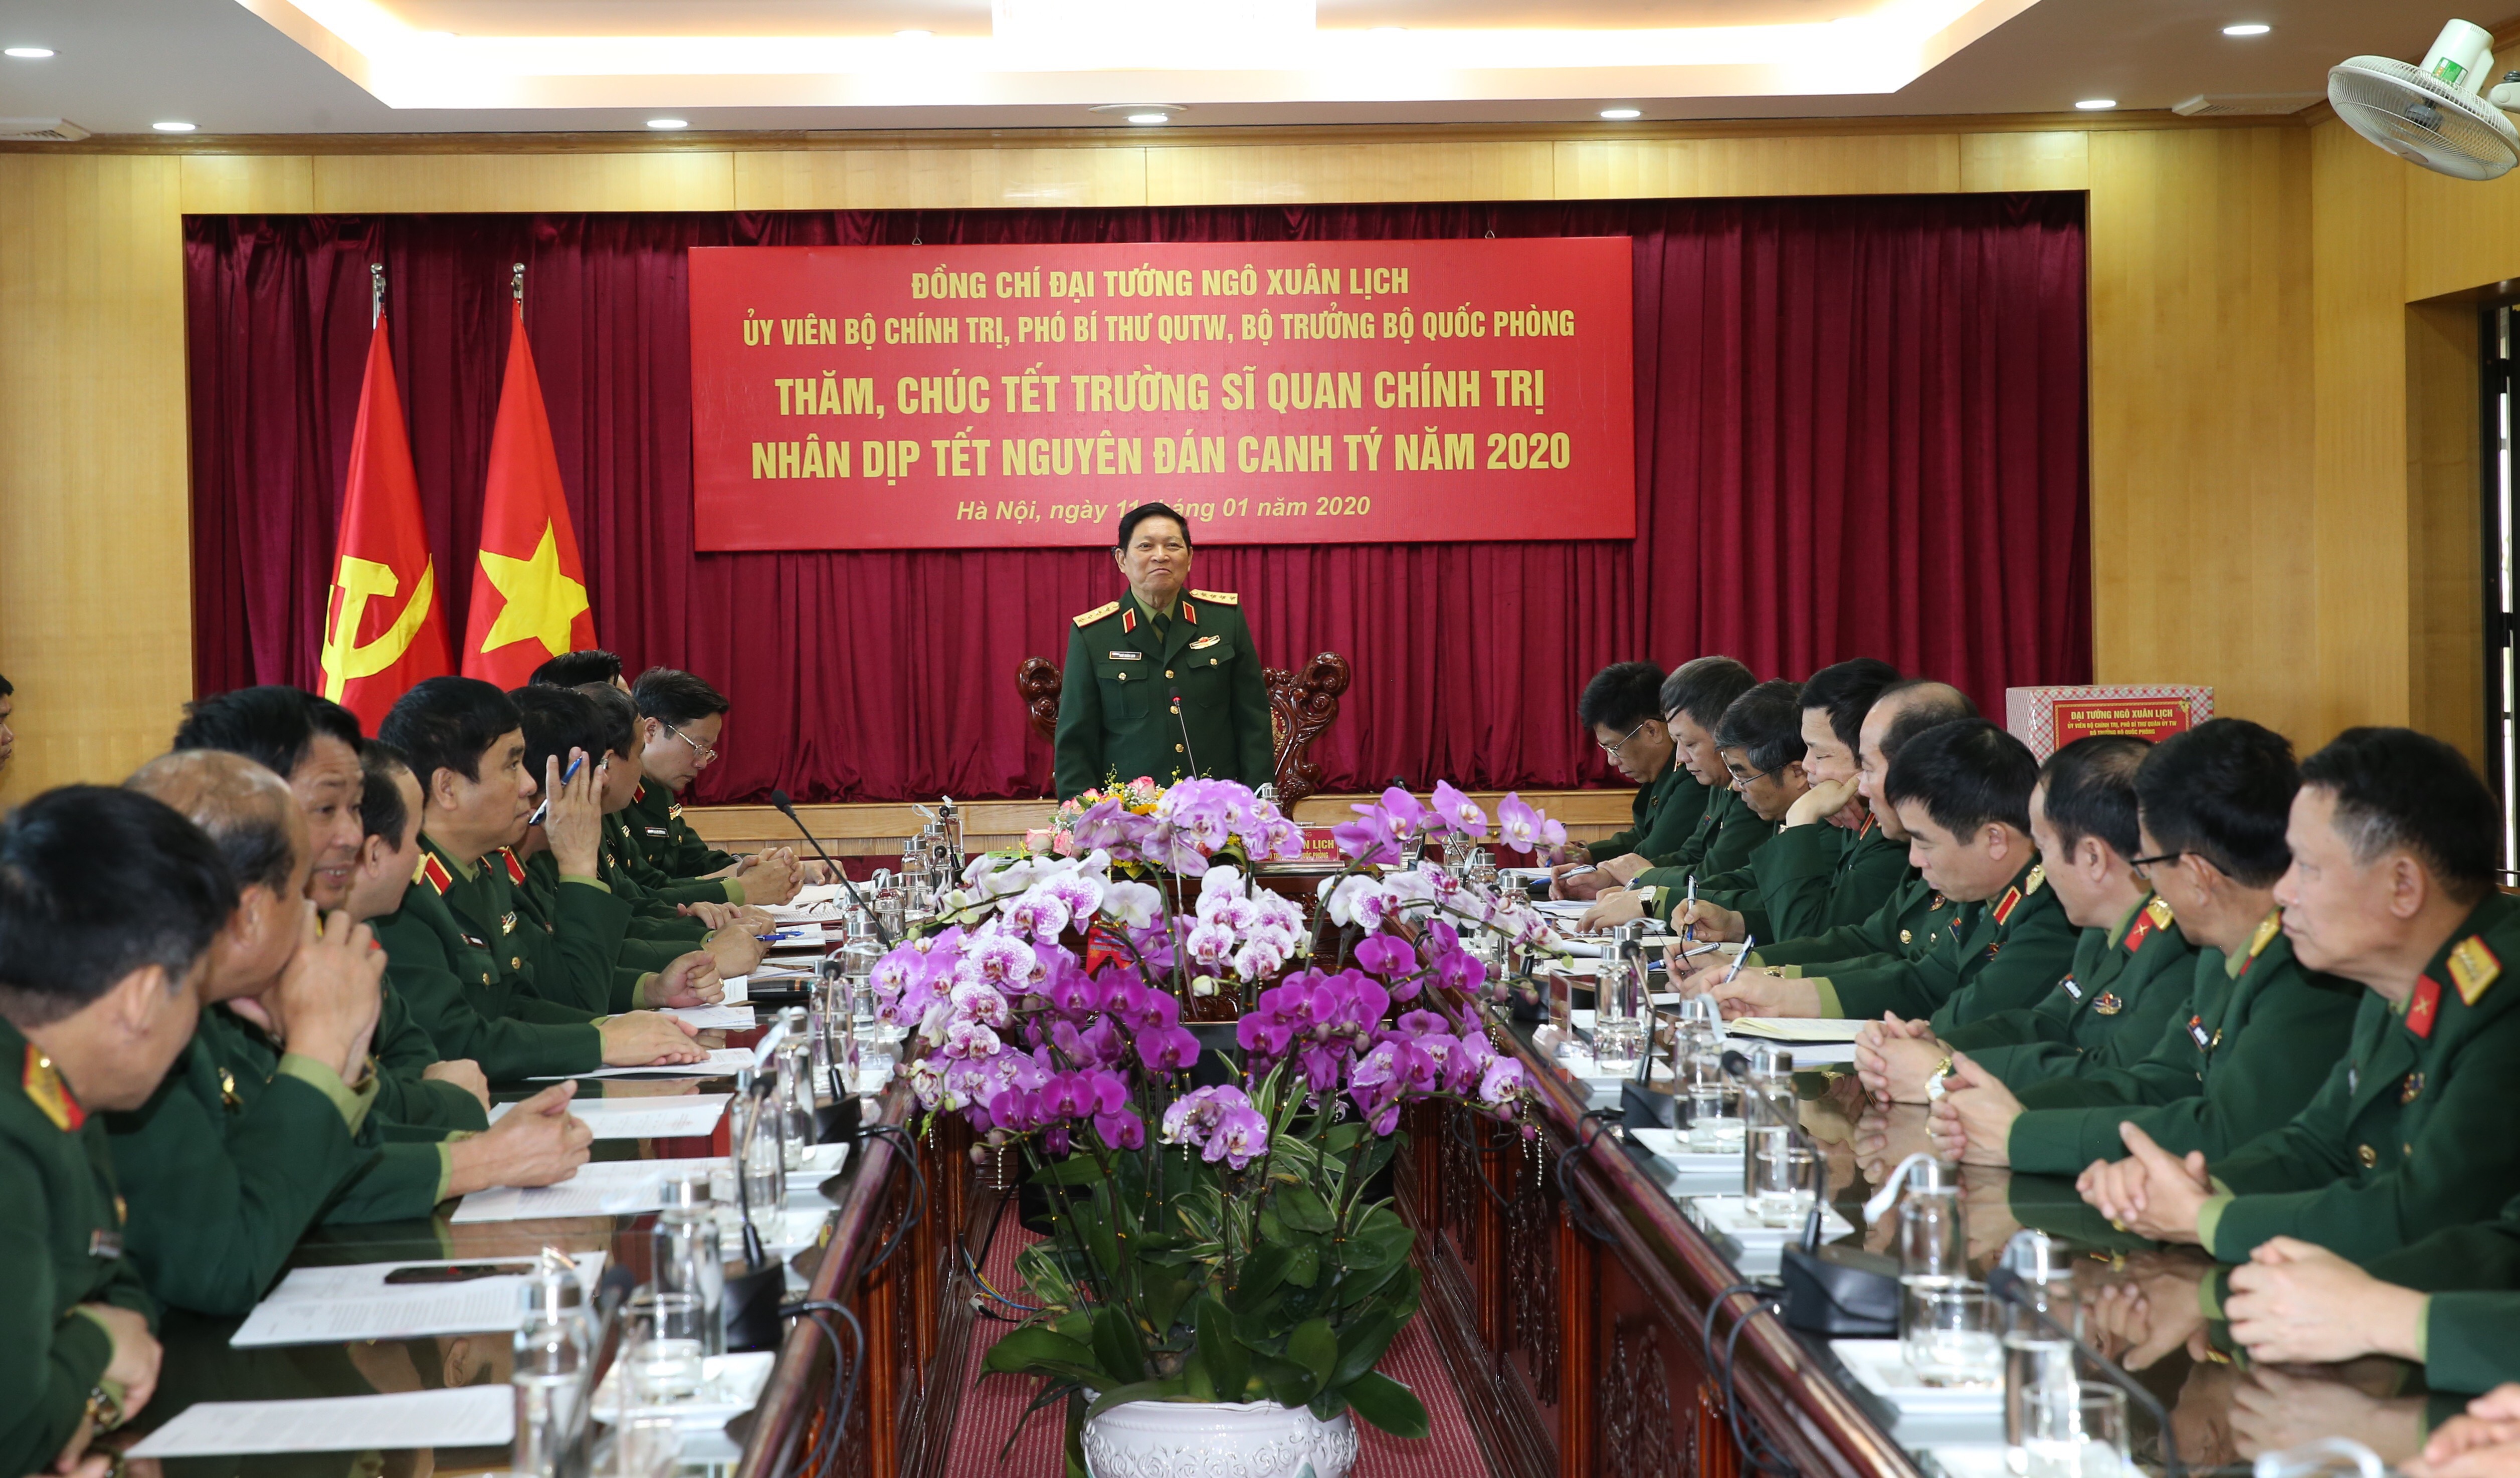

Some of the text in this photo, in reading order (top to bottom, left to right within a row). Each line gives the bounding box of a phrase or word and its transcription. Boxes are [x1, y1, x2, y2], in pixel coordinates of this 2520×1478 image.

[911, 263, 1409, 303] ĐỒNG CHÍ ĐẠI TƯỚNG NGÔ XUÂN LỊCH
[743, 302, 1574, 350] ỦY VIÊN BỘ CHÍNH TRỊ, PHÓ BÍ THƯ QUTW, BỘ TRƯỞNG BỘ QUỐC PHÒNG
[774, 362, 1543, 419] THĂM, CHÚC TẾT TRƯỜNG SĨ QUAN CHÍNH TRỊ
[752, 426, 1570, 486] NHÂN DỊP TẾT NGUYÊN ĐÁN CANH TÝ NĂM 2020
[957, 501, 988, 520] Hà
[996, 500, 1041, 524] Nội,
[1050, 500, 1108, 524] ngày
[1223, 498, 1248, 517] 01
[1258, 498, 1307, 516] năm
[1316, 496, 1371, 515] 2020
[2071, 708, 2173, 721] ĐẠI TƯỚNG NGÔ XUÂN LỊCH
[1302, 850, 1312, 858] UỐC
[1313, 839, 1334, 851] LỊCH
